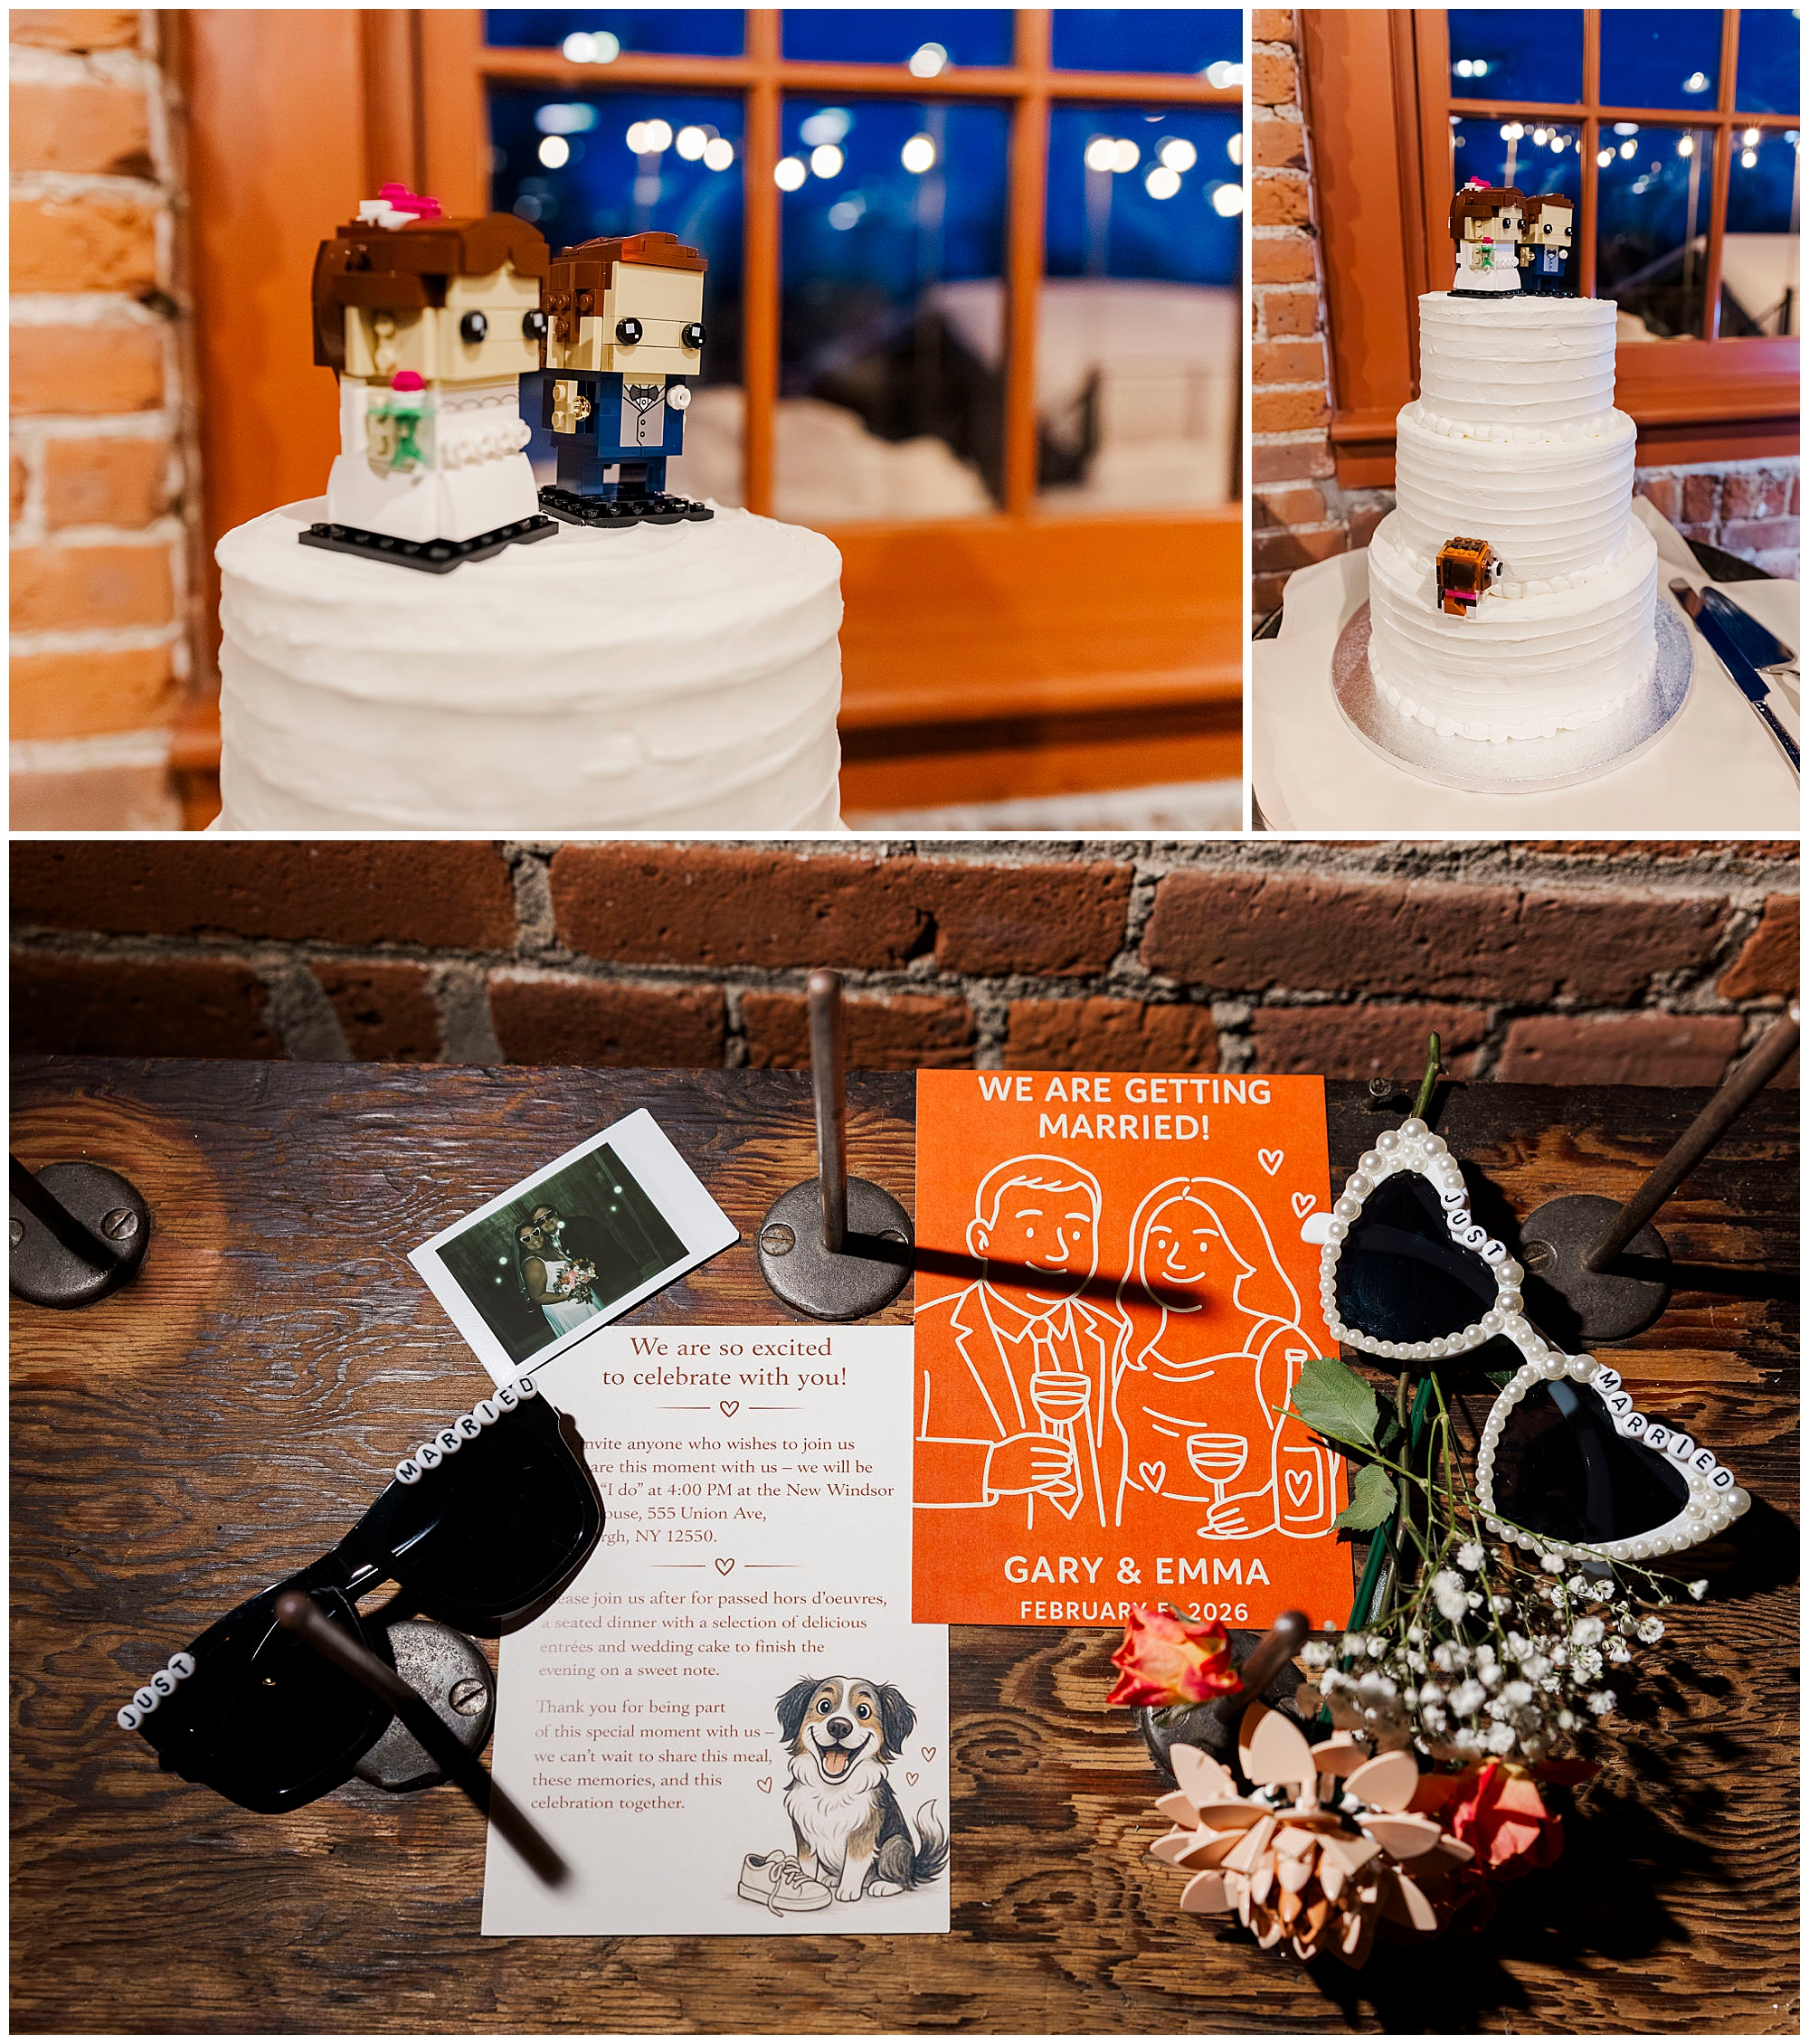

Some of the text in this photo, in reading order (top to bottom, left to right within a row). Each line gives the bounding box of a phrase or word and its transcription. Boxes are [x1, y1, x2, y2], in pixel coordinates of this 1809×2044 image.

[979, 1076, 1270, 1104] WE ARE GETTING
[1039, 1113, 1208, 1140] MARRIED!
[1443, 1191, 1504, 1259] JUST
[630, 1337, 833, 1357] We are so excited
[602, 1366, 847, 1392] to celebrate with you!
[398, 1376, 535, 1482] MARRIED
[1597, 1371, 1731, 1488] MARRIED
[627, 1441, 683, 1454] anyone
[687, 1435, 722, 1451] who
[726, 1436, 778, 1451] wishes
[781, 1439, 799, 1451] to
[800, 1437, 832, 1455] join
[838, 1441, 856, 1451] us
[619, 1459, 648, 1473] this
[652, 1462, 716, 1473] moment
[721, 1459, 755, 1473] with
[761, 1464, 778, 1473] us
[797, 1464, 819, 1473] we
[822, 1459, 850, 1473] will
[855, 1459, 873, 1473] be
[648, 1486, 663, 1497] at
[667, 1482, 702, 1497] 4:00
[707, 1482, 733, 1497] PM
[736, 1486, 752, 1497] at
[757, 1482, 781, 1497] the
[786, 1483, 822, 1497] New
[826, 1482, 895, 1497] Windsor
[647, 1506, 677, 1520] 555
[680, 1506, 728, 1519] Union
[733, 1506, 767, 1523] Ave,
[634, 1528, 661, 1543] NY
[668, 1528, 717, 1543] 12550.
[1005, 1556, 1270, 1585] GARY & EMMA
[543, 1590, 887, 1609] Please join us after for passed hors d’oeuvres,
[541, 1614, 867, 1629] a seated dinner with a selection of delicious
[1189, 1603, 1247, 1621] 2026
[539, 1639, 825, 1657] entrées and wedding cake to finish the
[538, 1663, 720, 1680] evening on a sweet note.
[123, 1657, 191, 1729] JUST
[535, 1699, 725, 1718] Thank you for being part
[534, 1723, 553, 1738] of
[554, 1723, 582, 1738] this
[585, 1724, 635, 1742] special
[639, 1727, 701, 1738] moment
[706, 1724, 739, 1737] with
[743, 1728, 761, 1738] us
[534, 1748, 772, 1765] we can’t wait to share this meal,
[532, 1772, 723, 1791] these memories, and this
[530, 1794, 686, 1813] celebration together.
